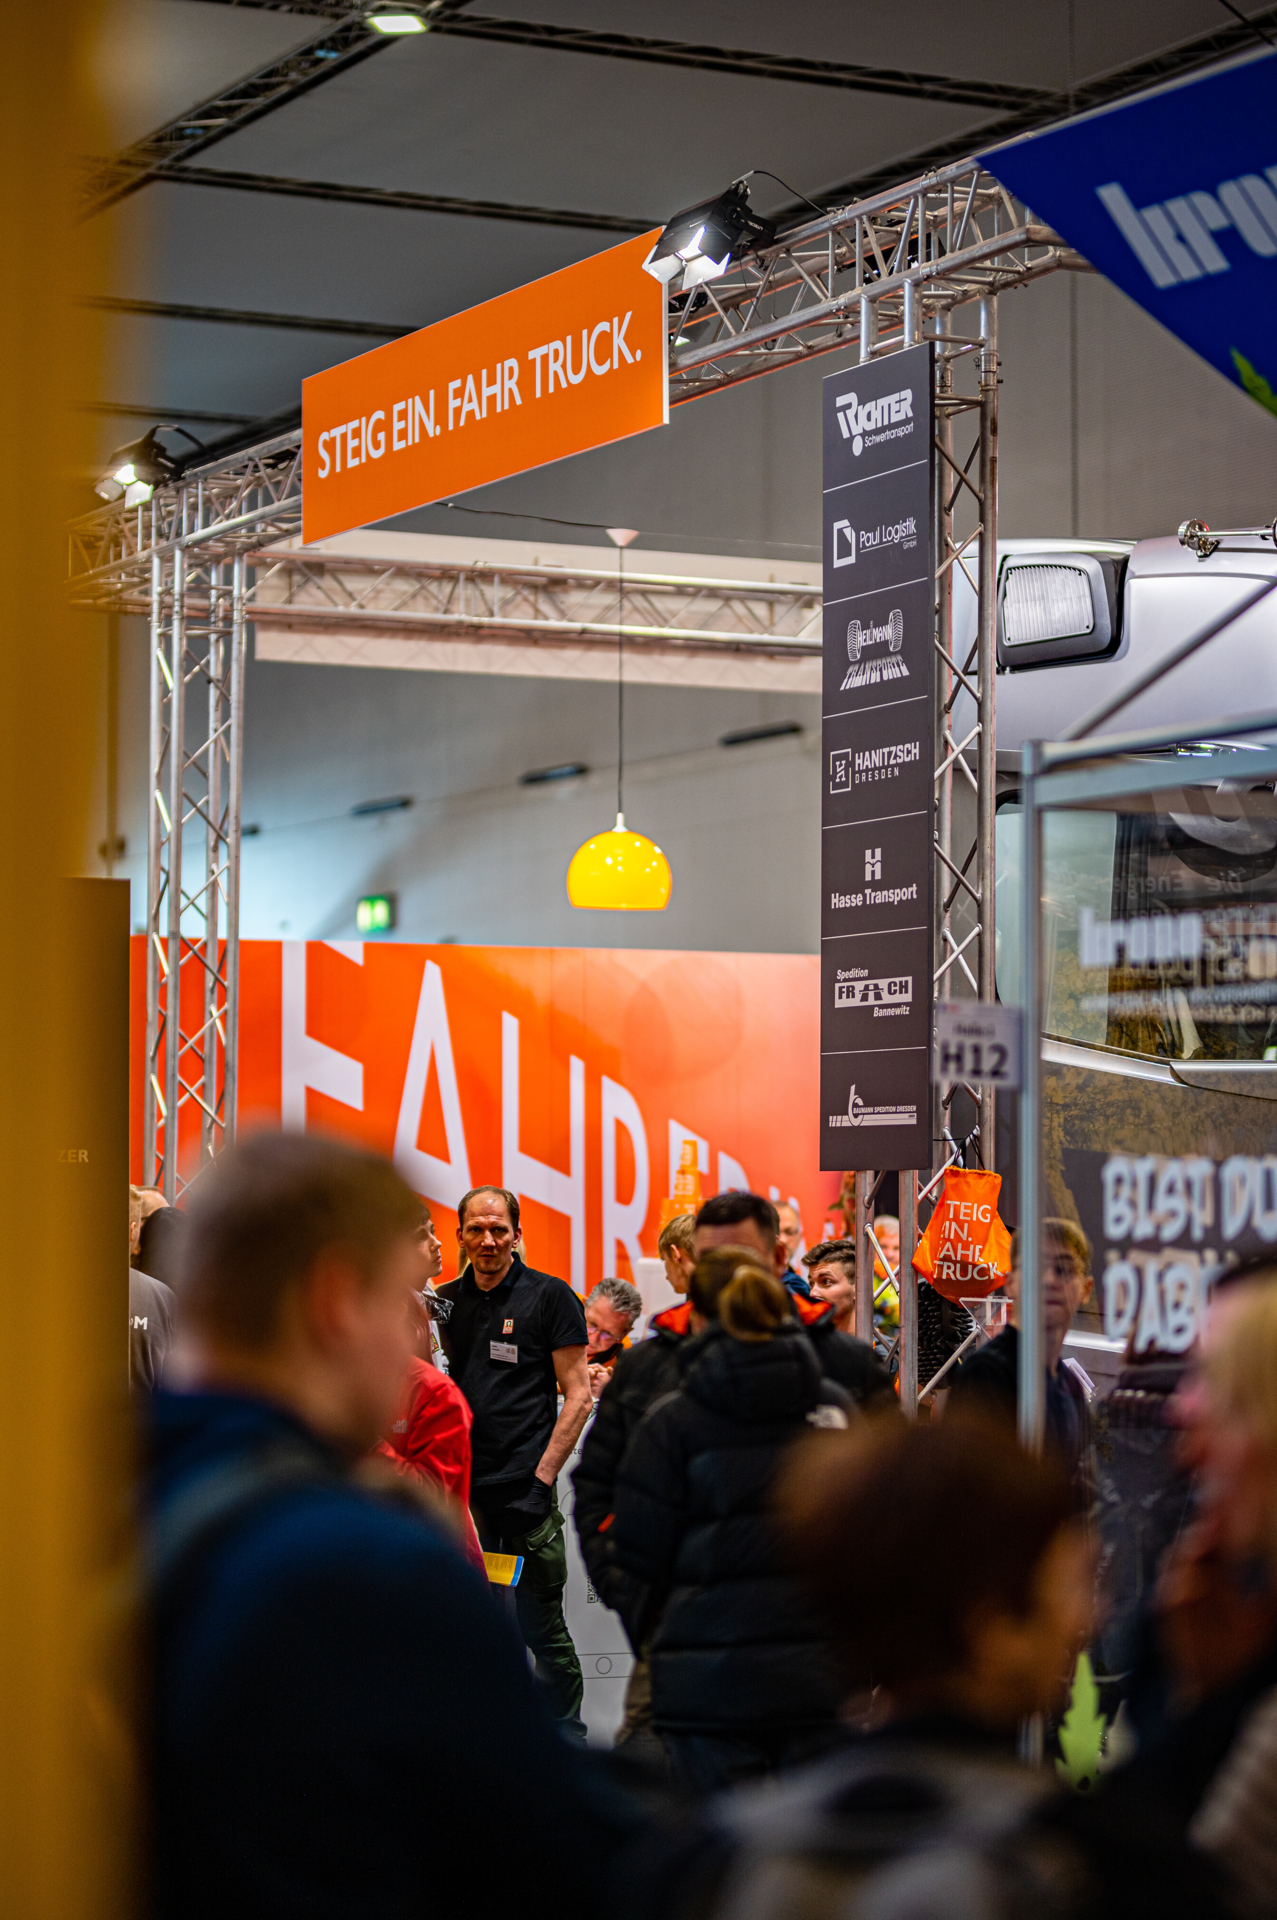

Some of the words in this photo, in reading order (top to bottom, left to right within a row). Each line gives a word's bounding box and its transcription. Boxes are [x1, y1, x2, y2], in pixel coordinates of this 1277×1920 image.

[1095, 164, 1277, 290] kro
[318, 410, 385, 478] STEIG
[392, 389, 441, 452] EIN.
[447, 357, 522, 430] FAHR
[528, 311, 642, 399] TRUCK.
[836, 388, 913, 439] RICHTER
[865, 421, 914, 447] Schwertransport
[860, 526, 879, 548] Paul
[882, 517, 917, 543] Logistik
[858, 624, 893, 647] HEILMANN
[840, 653, 910, 691] TRANSPORTE
[855, 741, 920, 771] HANITZSCH
[855, 766, 899, 783] DRESDEN
[831, 892, 863, 909] Hasse
[865, 883, 917, 905] Transport
[837, 968, 869, 981] Spedition
[873, 1005, 910, 1017] Bannewitz
[940, 1040, 1009, 1079] H12
[874, 1105, 897, 1113] SPEDITION
[897, 1104, 917, 1112] DRESDEN
[1102, 1155, 1214, 1243] BIST
[1220, 1155, 1277, 1243] DU
[941, 1220, 973, 1242] IN.
[937, 1241, 985, 1262] AHR
[934, 1260, 1005, 1282] TRUCK
